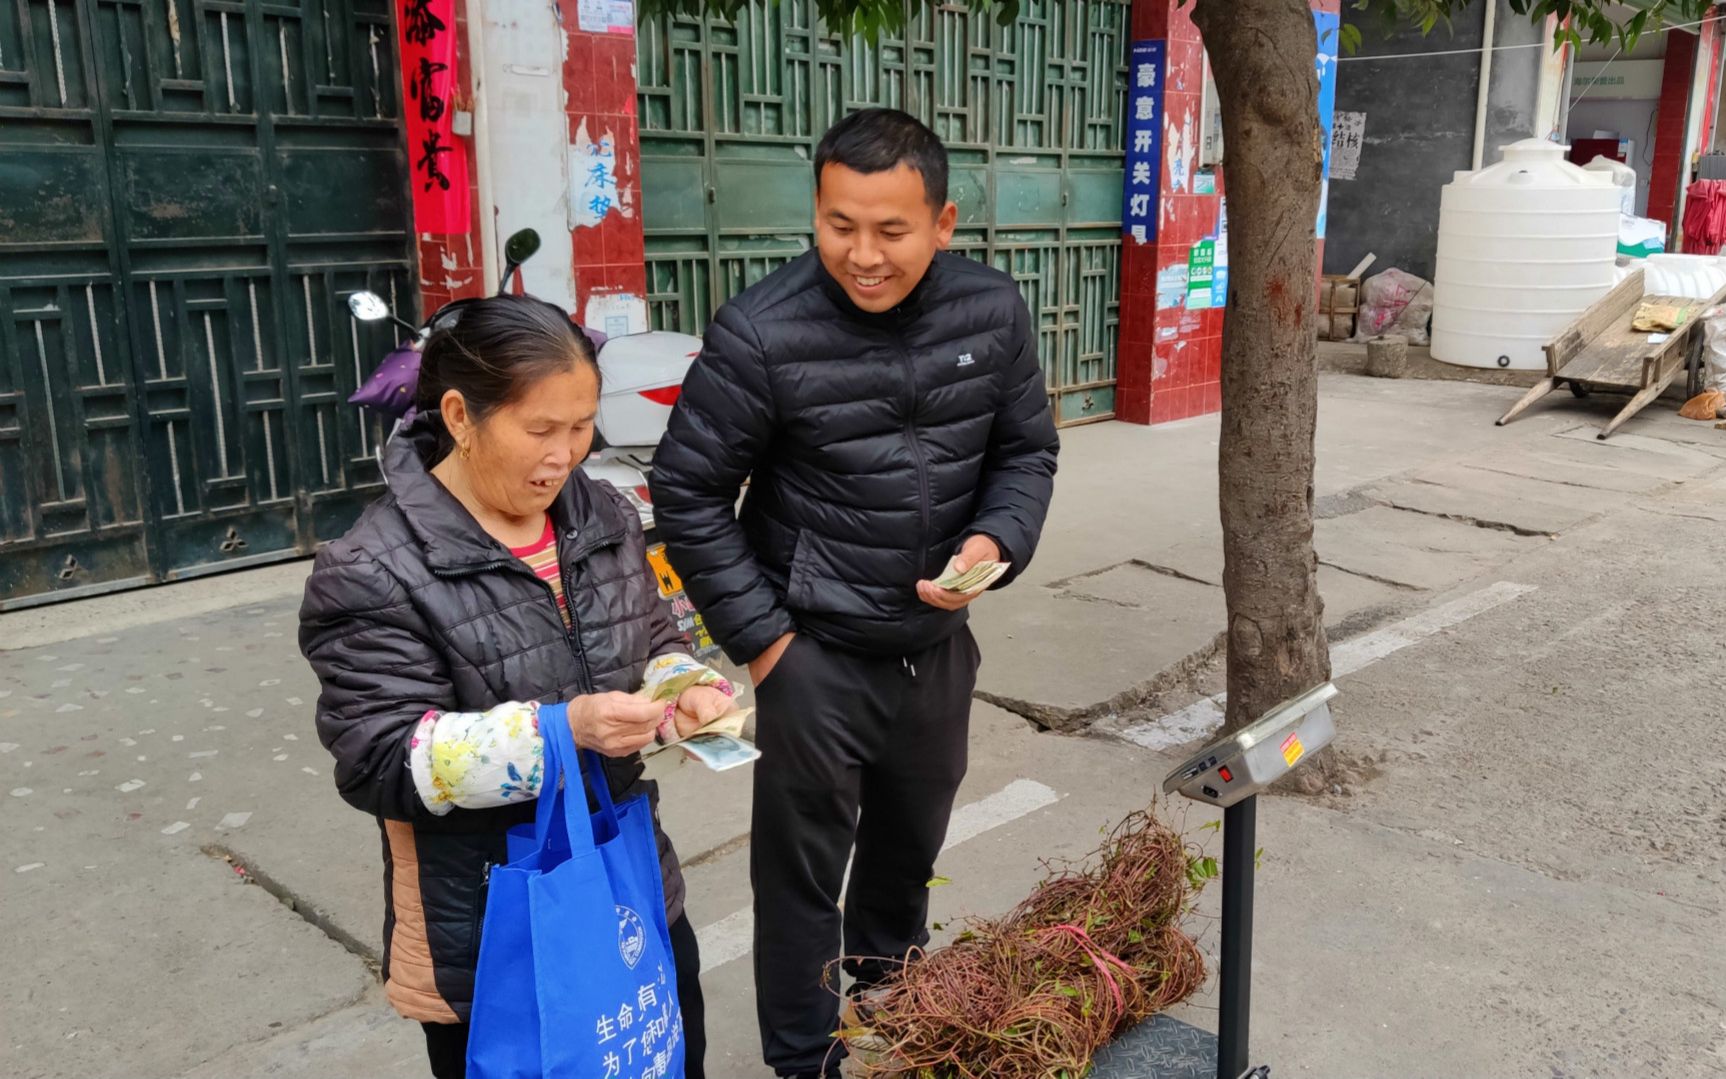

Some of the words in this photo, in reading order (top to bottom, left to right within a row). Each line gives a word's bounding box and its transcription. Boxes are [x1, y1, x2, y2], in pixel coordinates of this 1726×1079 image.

[1130, 63, 1156, 245] 豪意开关灯具
[596, 960, 666, 1044] 生命有
